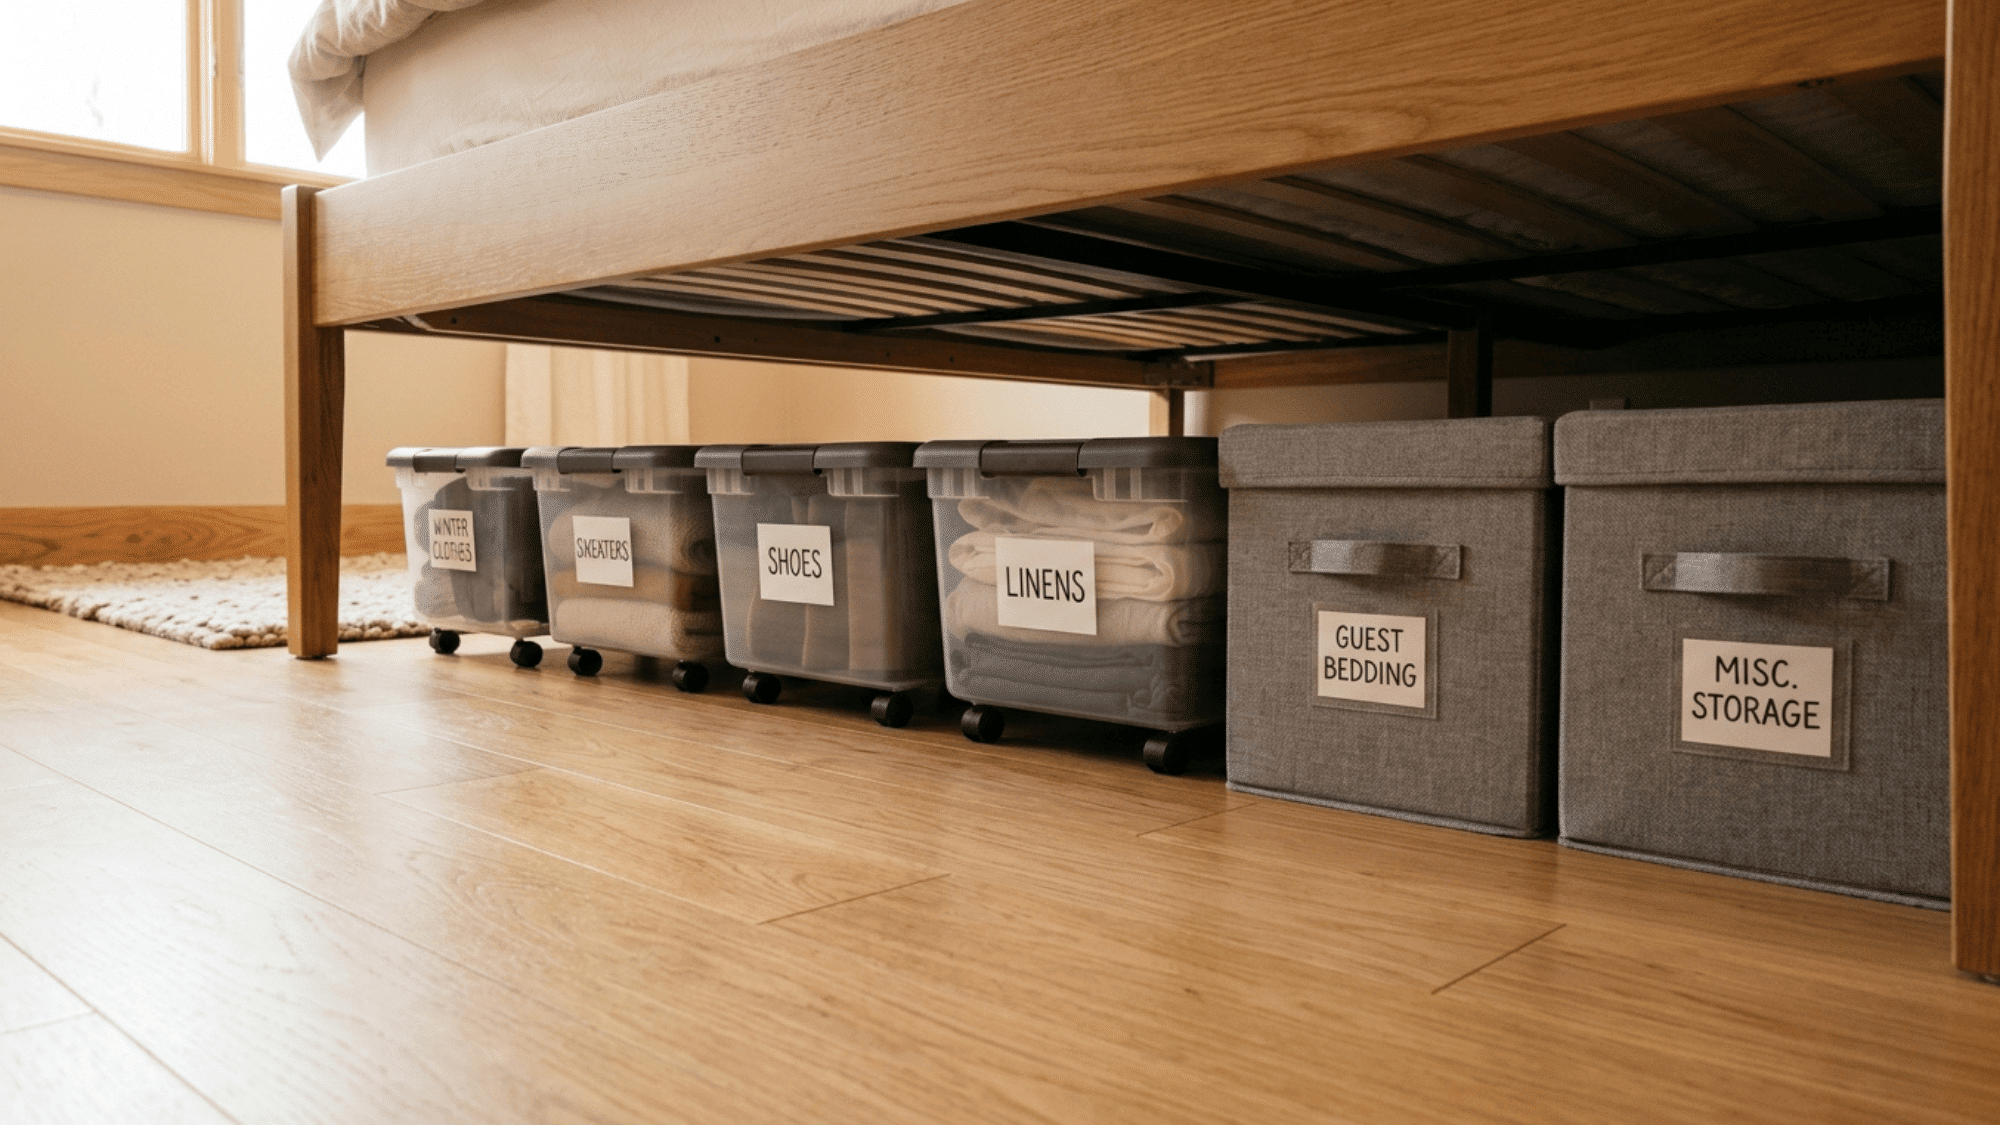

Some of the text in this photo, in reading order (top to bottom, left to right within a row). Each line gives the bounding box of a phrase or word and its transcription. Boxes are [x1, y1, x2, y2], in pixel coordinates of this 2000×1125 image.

[768, 546, 822, 579] SHOES
[1005, 566, 1085, 604] LINENS
[1335, 624, 1404, 653] GUEST
[1323, 656, 1417, 688] BEDDING
[1715, 655, 1798, 690] MISC.
[1691, 691, 1821, 730] STORAGE
